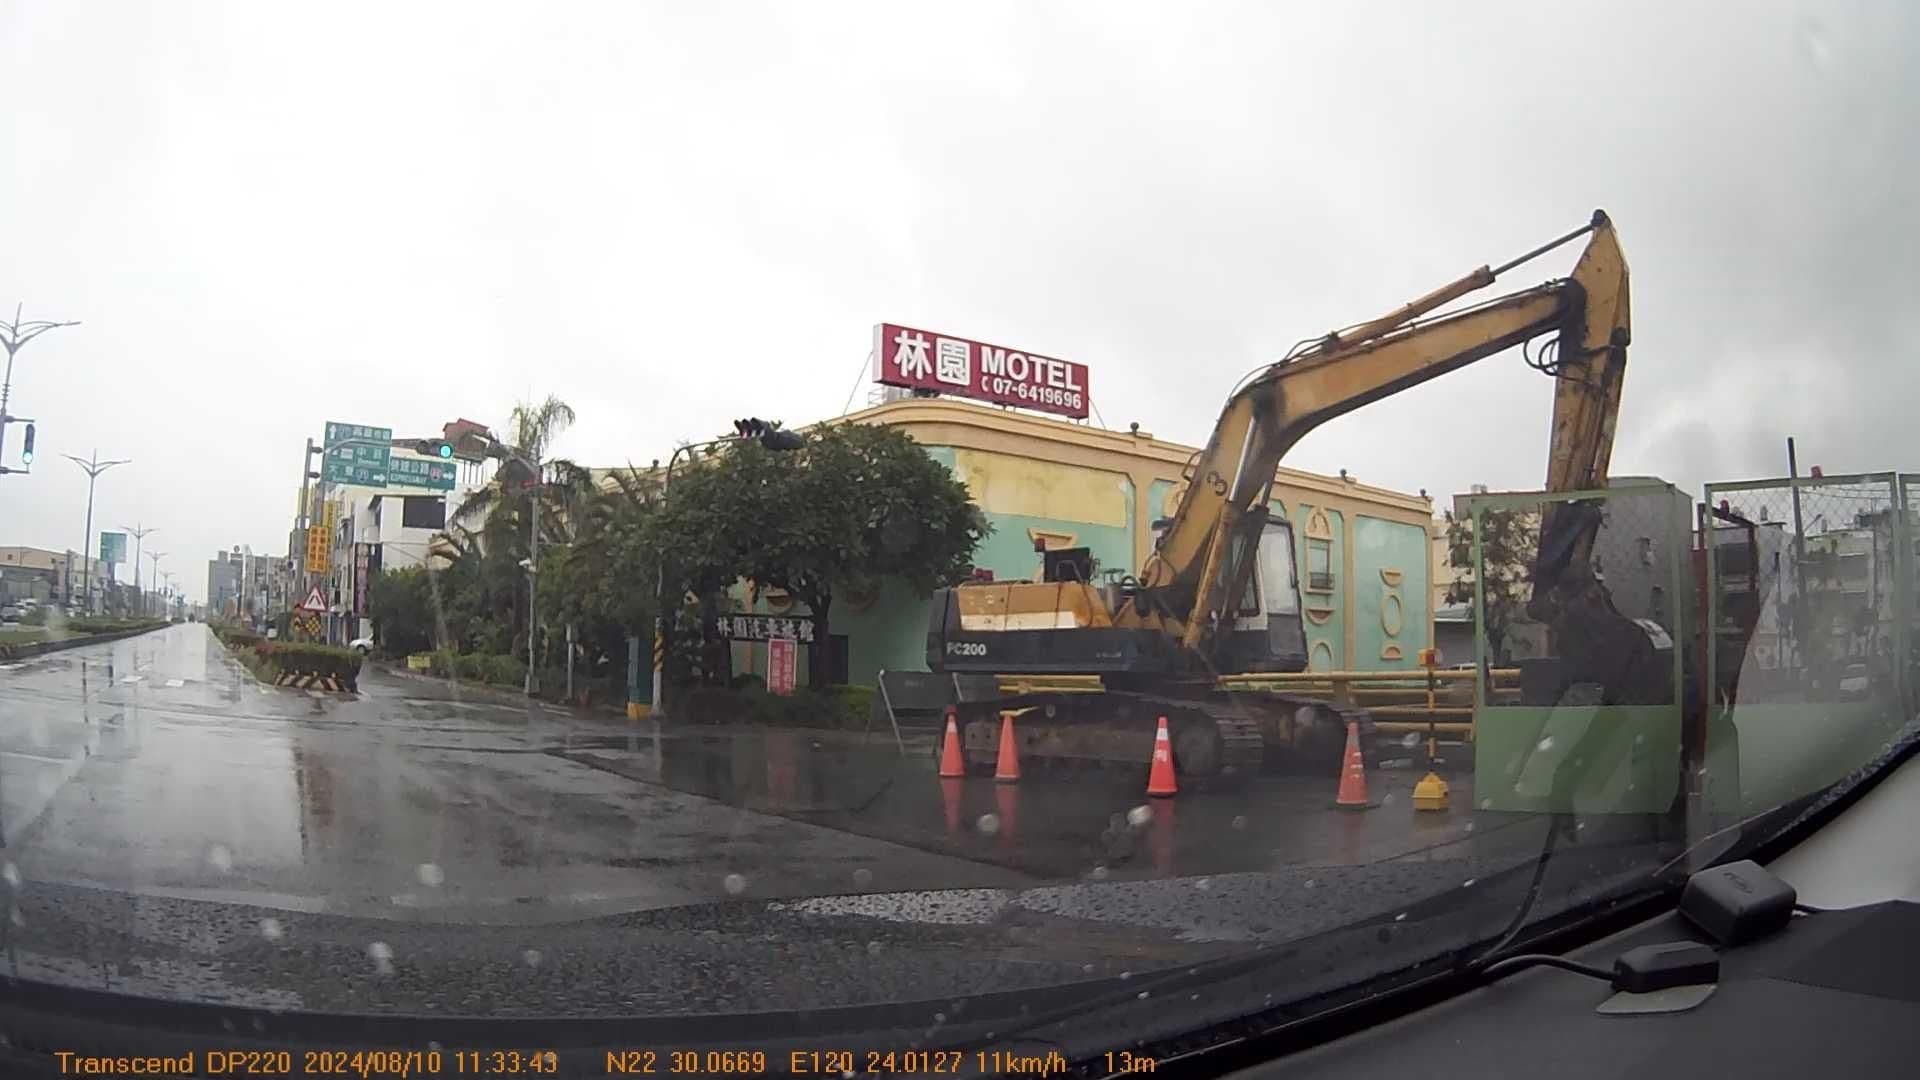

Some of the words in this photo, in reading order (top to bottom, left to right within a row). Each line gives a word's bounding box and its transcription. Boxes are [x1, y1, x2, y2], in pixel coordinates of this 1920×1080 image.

[894, 330, 970, 386] 林園
[980, 345, 1081, 391] MOTEL
[993, 377, 1081, 409] 07-6419696
